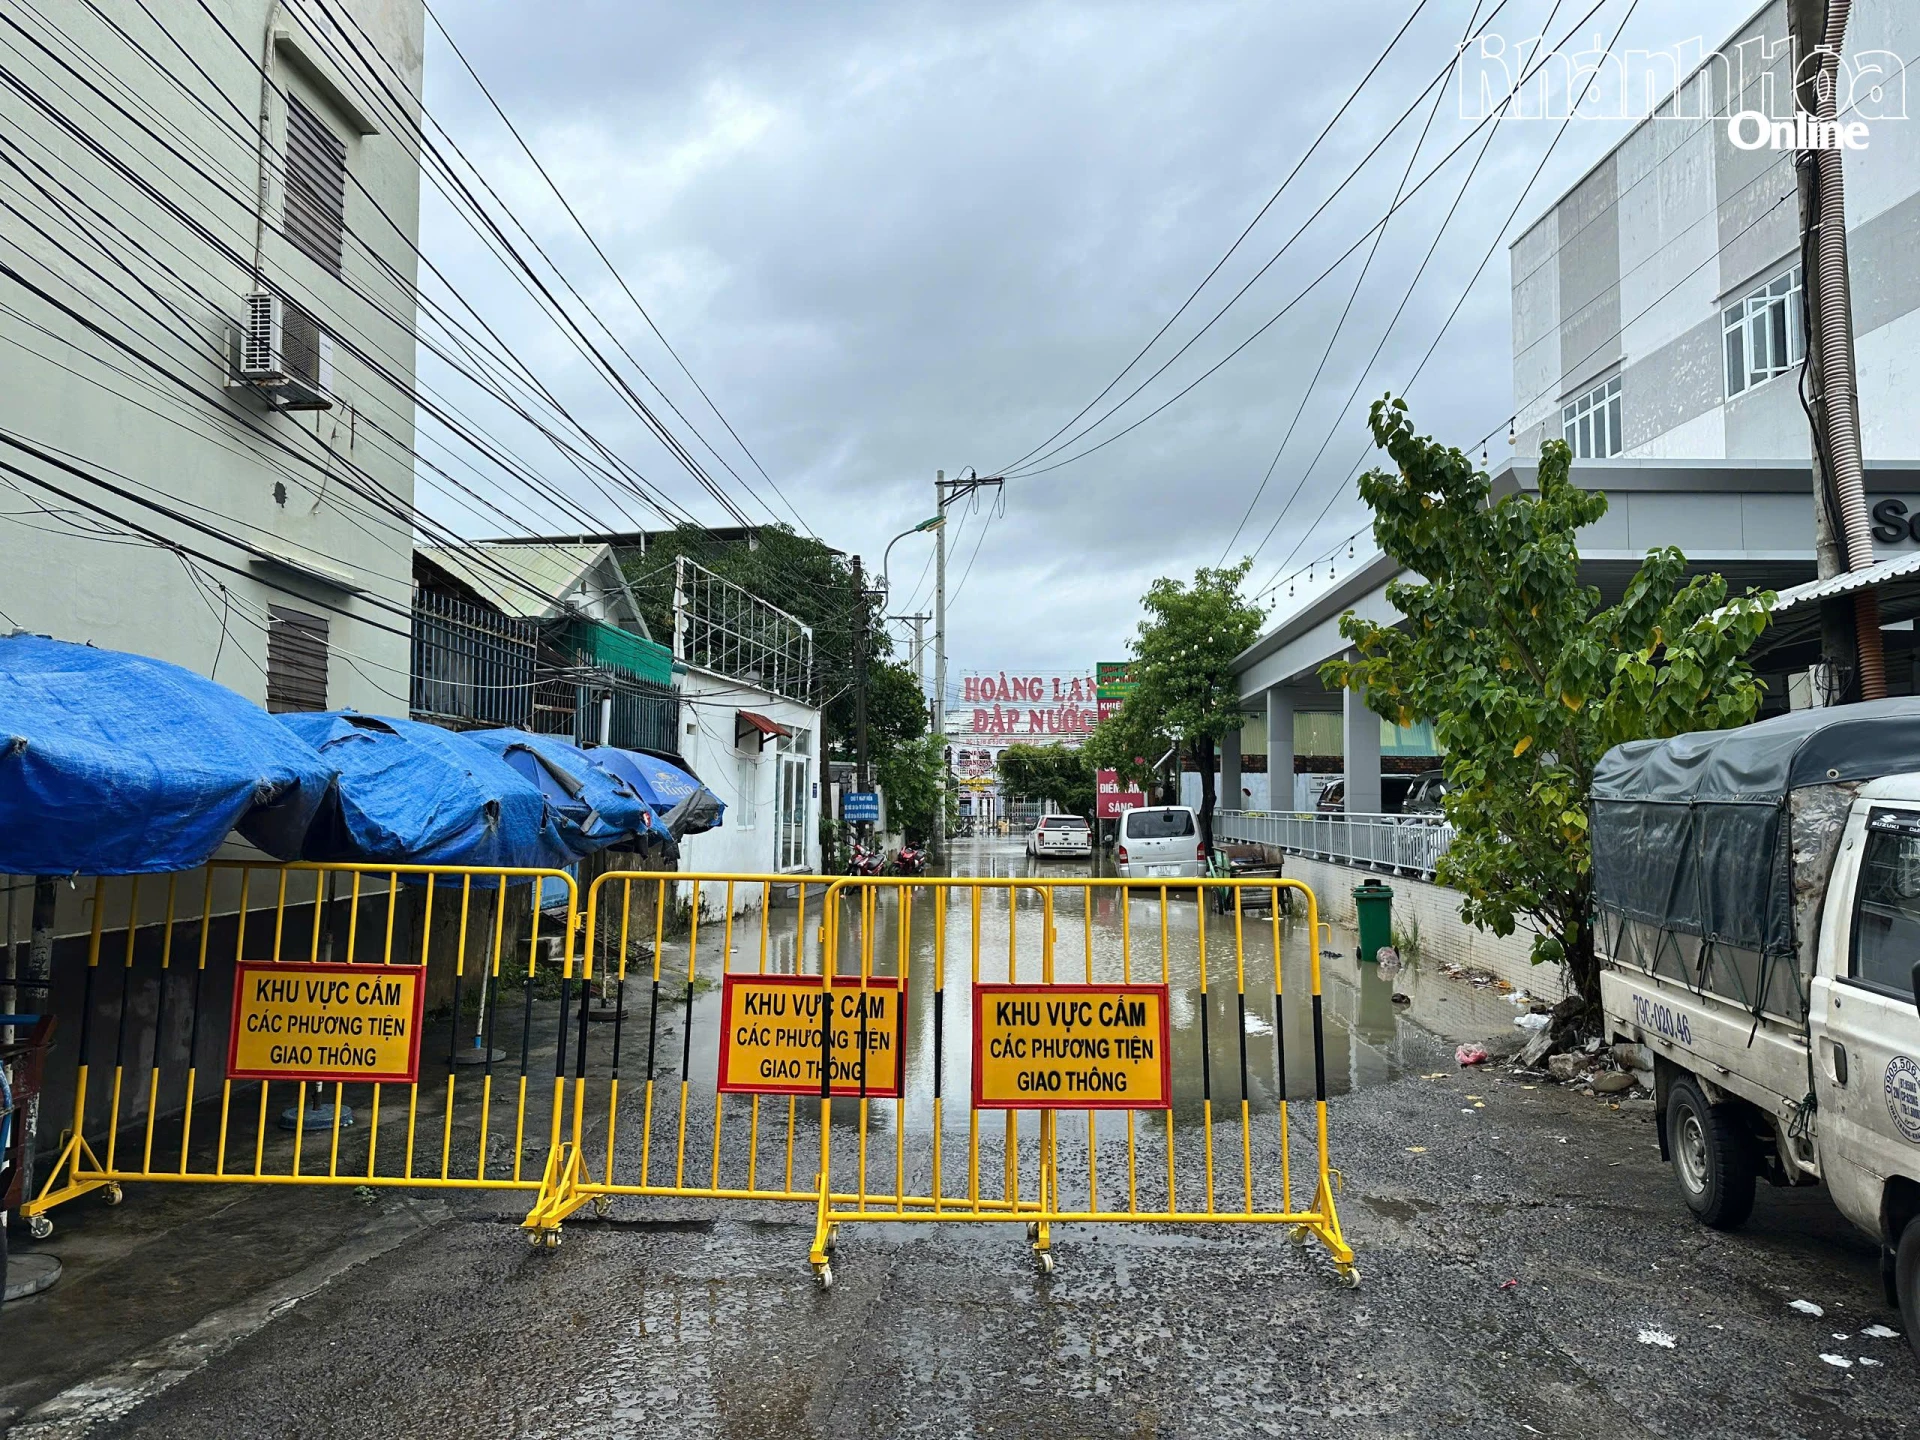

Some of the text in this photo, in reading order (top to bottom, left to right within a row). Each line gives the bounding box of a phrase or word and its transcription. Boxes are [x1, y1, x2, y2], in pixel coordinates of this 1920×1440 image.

[964, 671, 1098, 702] HOÀNG LAN
[973, 702, 1094, 739] ĐẬP NƯỚC
[1124, 782, 1142, 794] ÂM
[1108, 801, 1134, 813] SÁNG
[1872, 821, 1900, 830] SUZUKI
[256, 976, 401, 1011] KHU VỰC CẤM
[744, 992, 786, 1016] KHU
[246, 1009, 405, 1041] CÁC PHƯƠNG TIỆN
[996, 995, 1146, 1033] KHU VỰC CẤM
[1633, 994, 1692, 1046] 79C-020.46
[736, 1022, 771, 1047] CÁC
[270, 1043, 376, 1066] GIAO THÔNG
[990, 1033, 1153, 1064] CÁC PHƯƠNG TIỆN
[760, 1059, 801, 1079] GIAO
[1017, 1067, 1127, 1092] GIAO THÔNG
